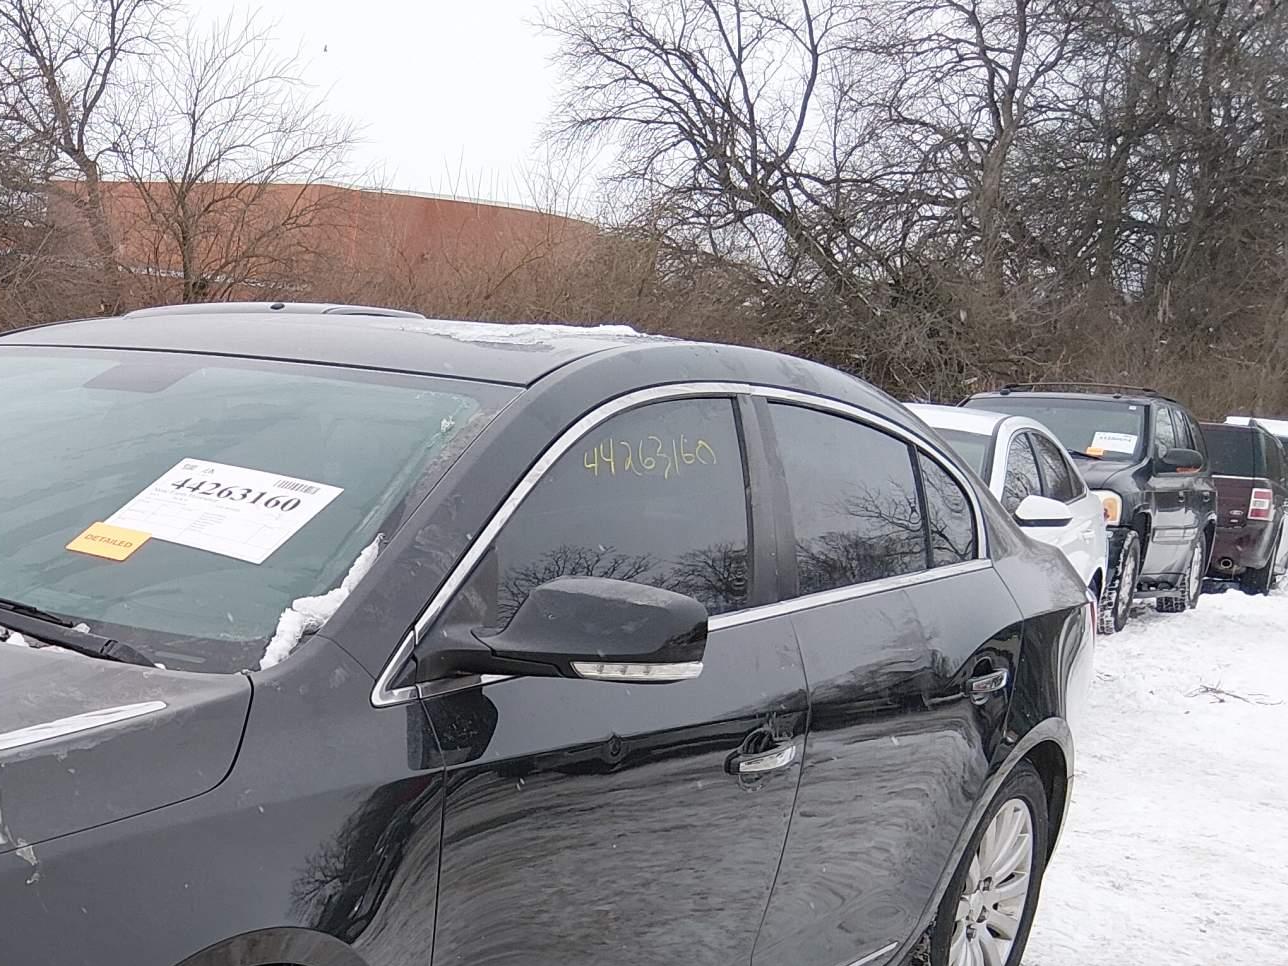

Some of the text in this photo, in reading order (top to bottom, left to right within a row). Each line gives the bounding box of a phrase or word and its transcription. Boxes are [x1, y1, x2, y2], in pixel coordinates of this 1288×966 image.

[584, 433, 717, 480] 44263160
[171, 477, 302, 513] 44263160
[84, 533, 133, 549] DETAILED
